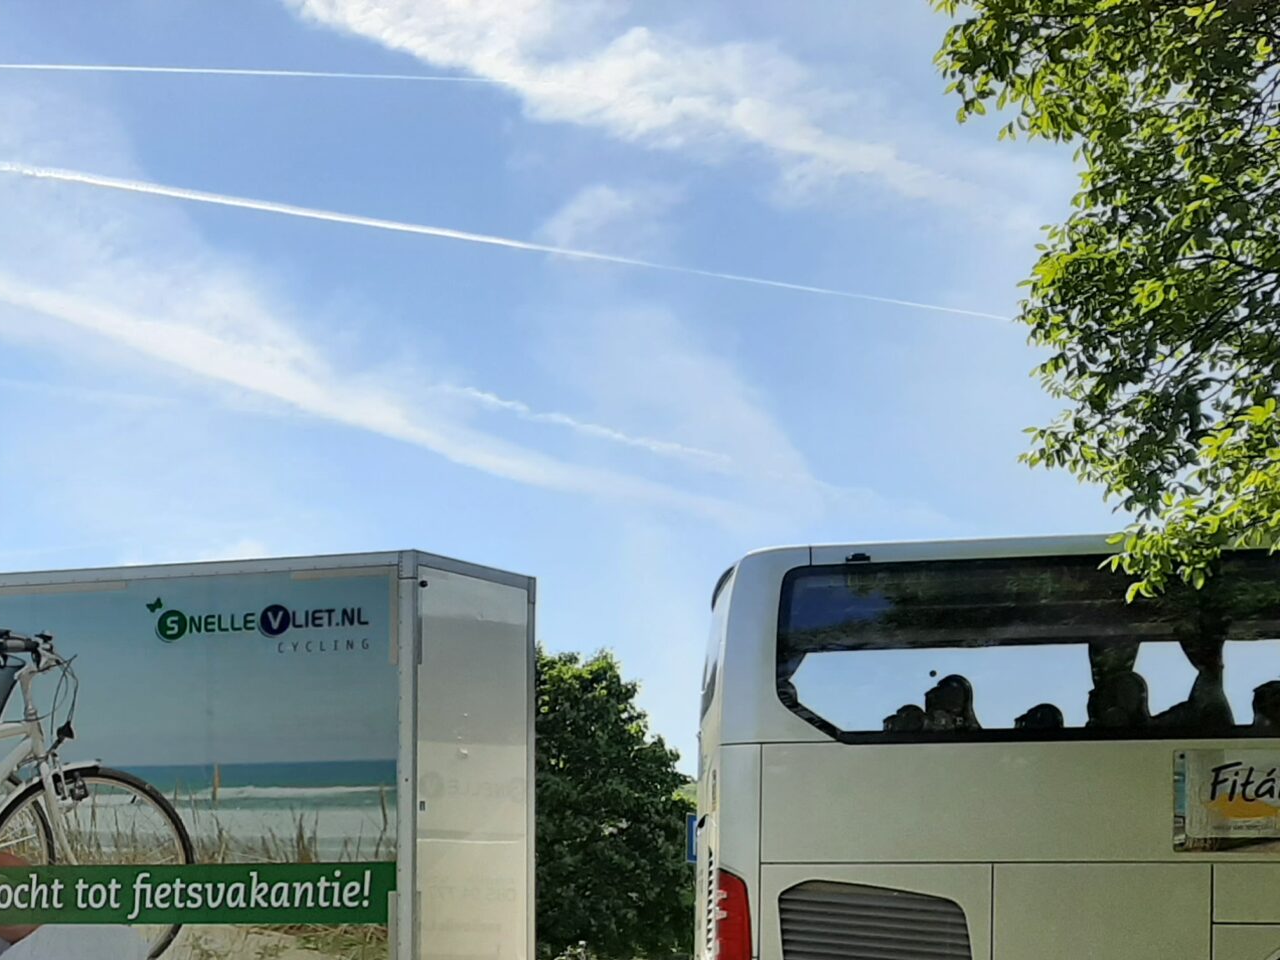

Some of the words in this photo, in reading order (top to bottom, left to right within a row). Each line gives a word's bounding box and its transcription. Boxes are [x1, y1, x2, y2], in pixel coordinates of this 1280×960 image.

[277, 638, 370, 654] CYCLING
[1210, 761, 1280, 802] Fitá
[74, 878, 122, 909] tot
[127, 869, 372, 920] fietsvakantie!
